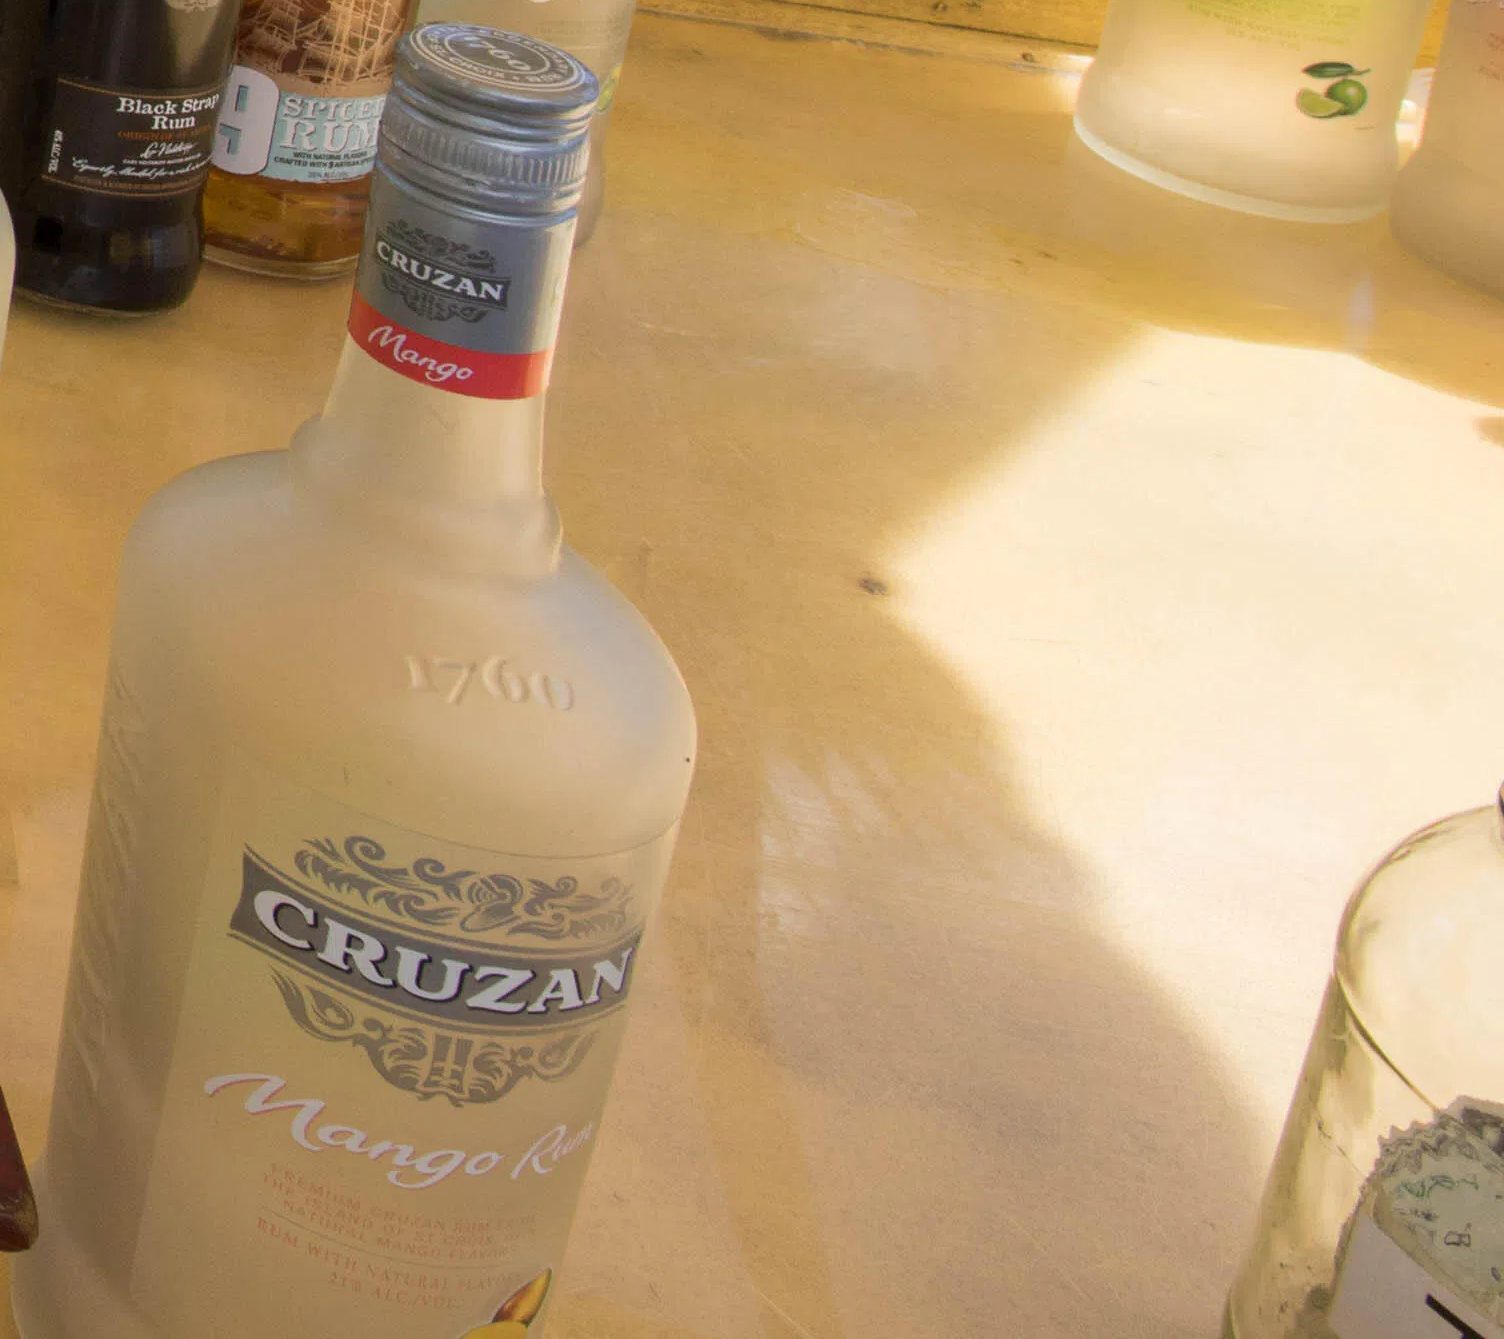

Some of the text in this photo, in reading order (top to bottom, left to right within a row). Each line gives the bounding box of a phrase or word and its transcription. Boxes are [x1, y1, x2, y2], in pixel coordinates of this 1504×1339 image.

[116, 93, 220, 116] Black Strap
[151, 114, 196, 131] Rum
[375, 240, 506, 303] CRUZAN
[367, 323, 476, 384] Mango
[252, 888, 634, 1016] CRUZAN
[203, 1071, 595, 1192] Mango Rum
